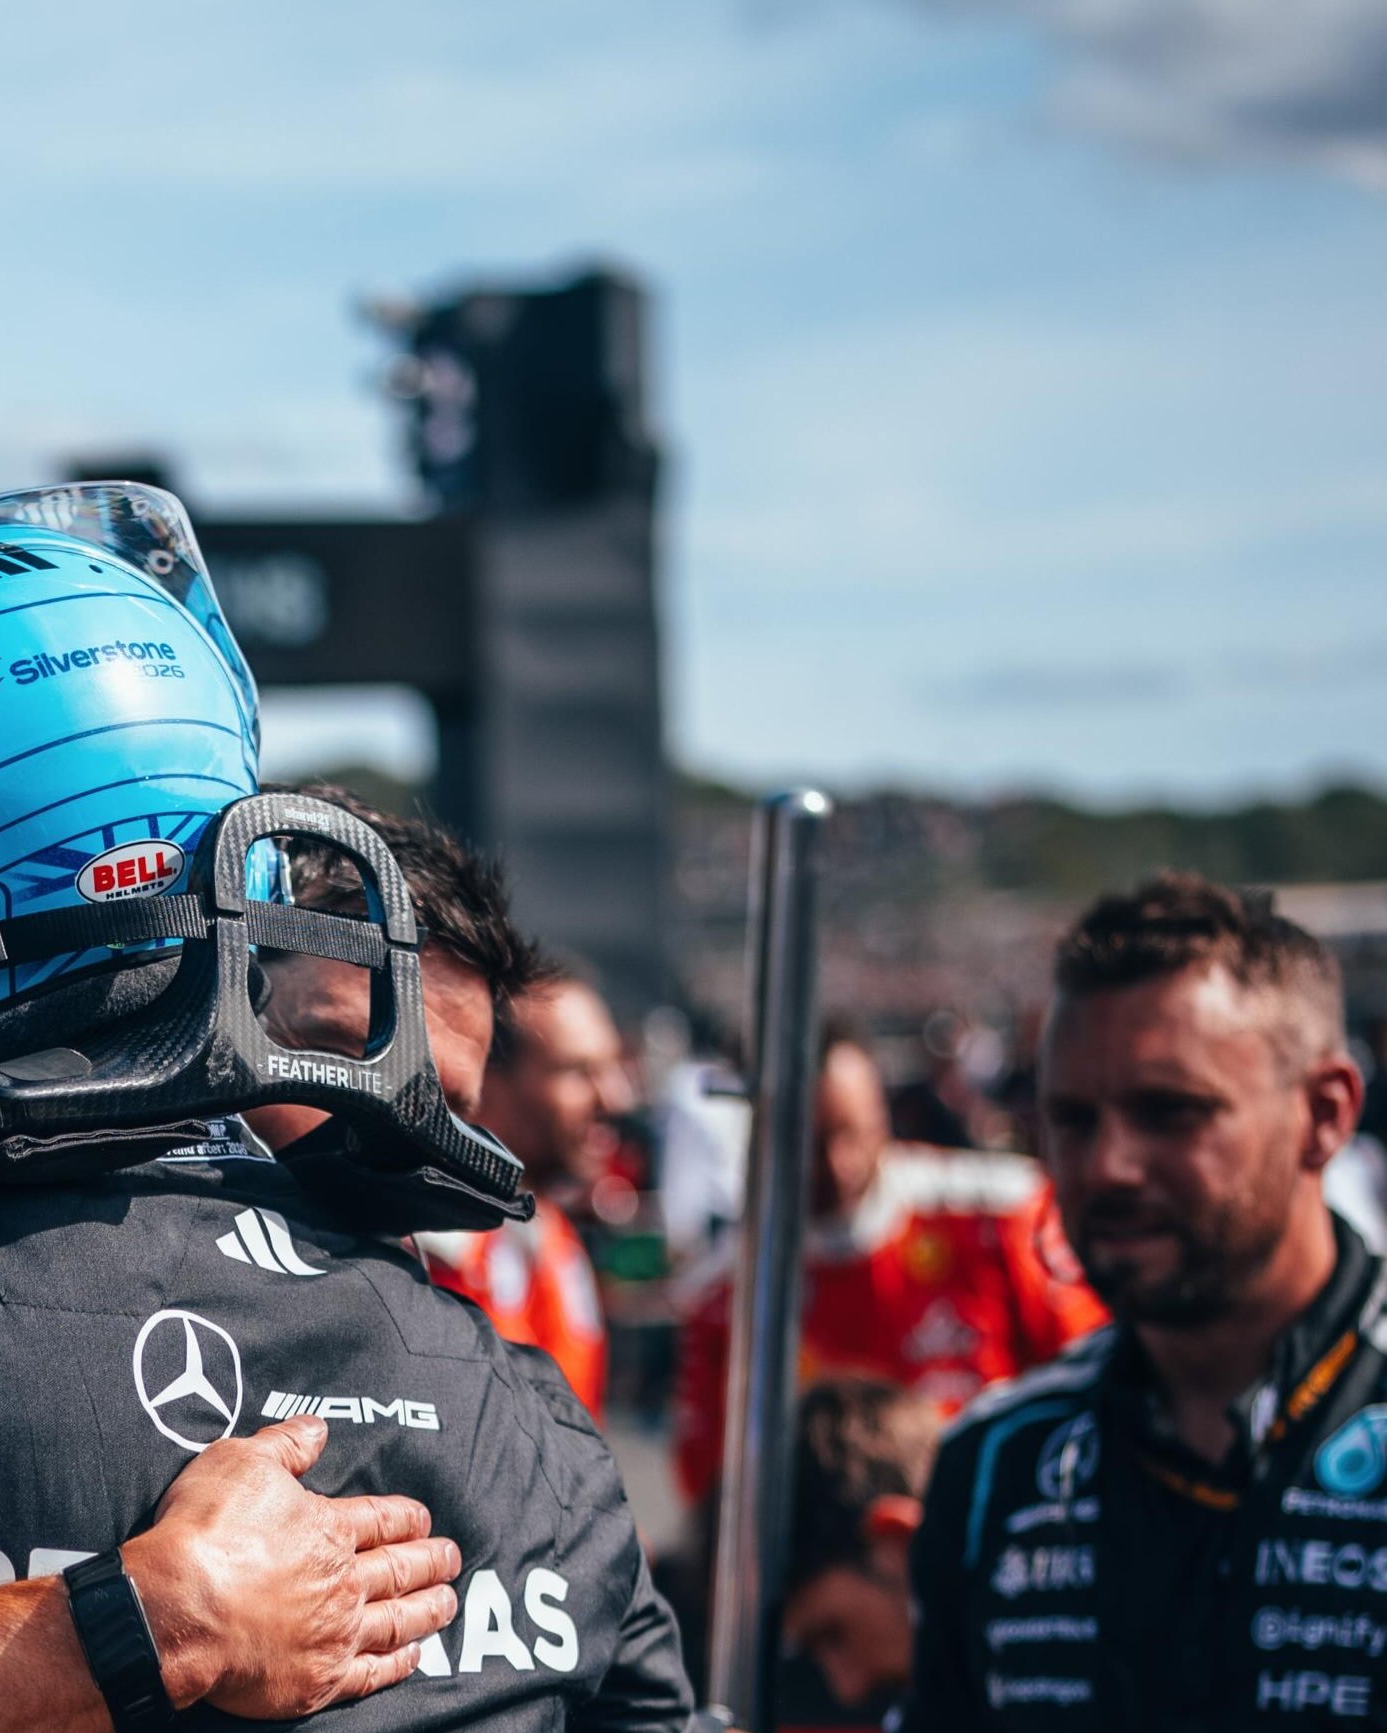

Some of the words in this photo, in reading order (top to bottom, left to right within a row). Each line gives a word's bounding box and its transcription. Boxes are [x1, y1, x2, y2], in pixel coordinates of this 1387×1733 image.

[9, 640, 176, 685] Silverstone
[133, 664, 185, 678] 026
[93, 852, 173, 893] BELL
[106, 880, 165, 900] HELMETS
[267, 1055, 382, 1095] FEATHERLITE
[314, 1397, 440, 1430] AMG
[1256, 1670, 1371, 1716] HPE
